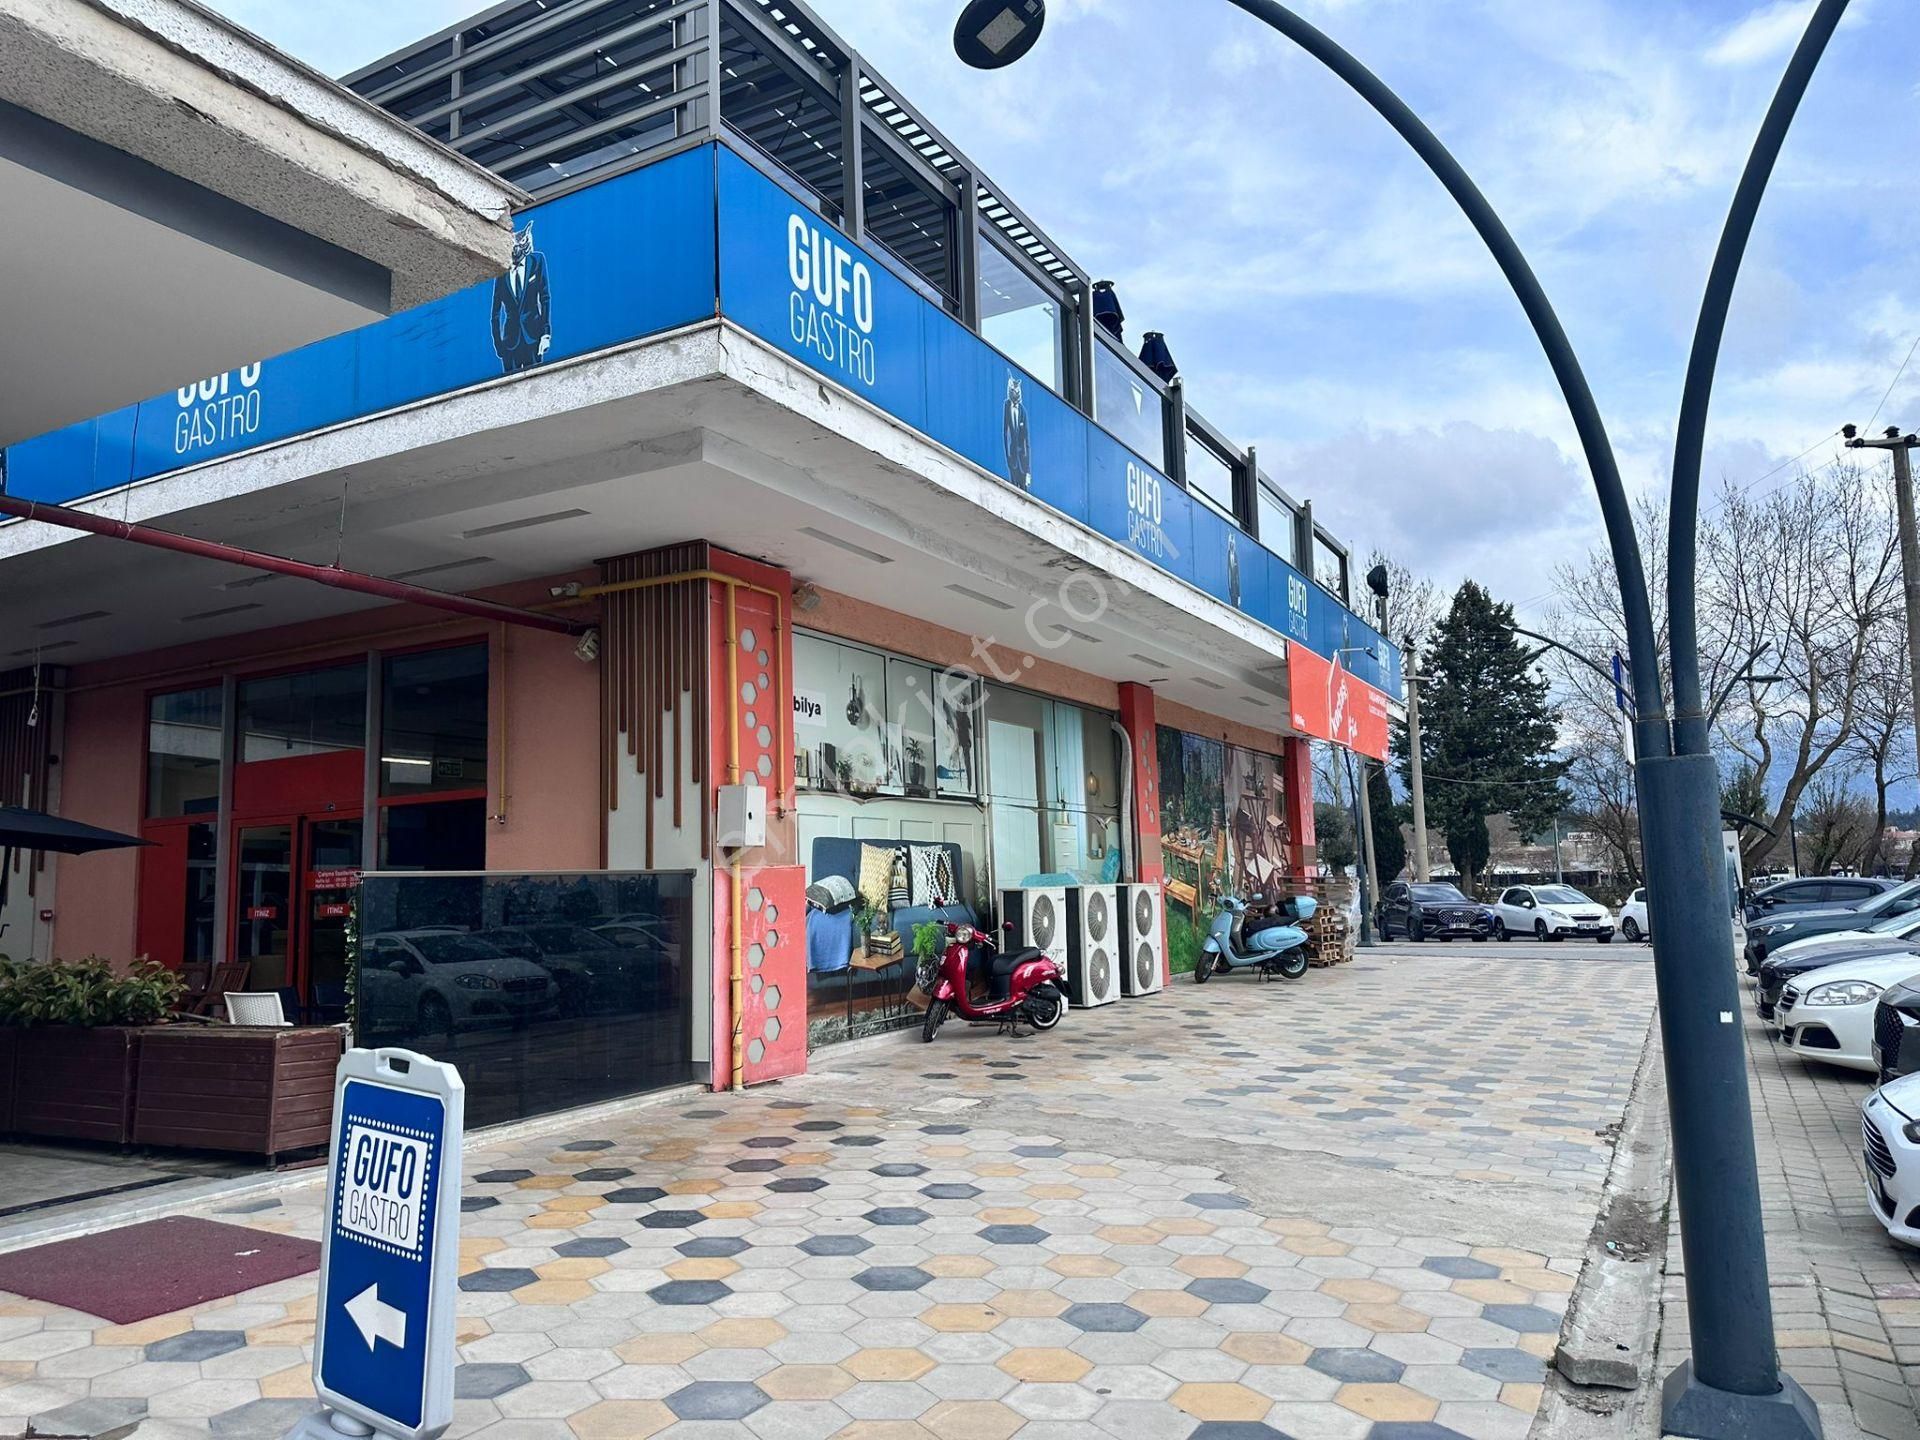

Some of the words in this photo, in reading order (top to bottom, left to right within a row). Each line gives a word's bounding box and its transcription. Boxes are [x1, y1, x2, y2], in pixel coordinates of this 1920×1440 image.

[788, 213, 873, 334] GUFO
[790, 291, 875, 386] GASTRO
[175, 389, 260, 454] GASTRO
[1127, 461, 1161, 525] GUFO
[1127, 510, 1163, 558] GASTRO
[1288, 574, 1307, 617] GUFO
[353, 1134, 417, 1199] GUFO
[349, 1189, 411, 1240] GASTRO
